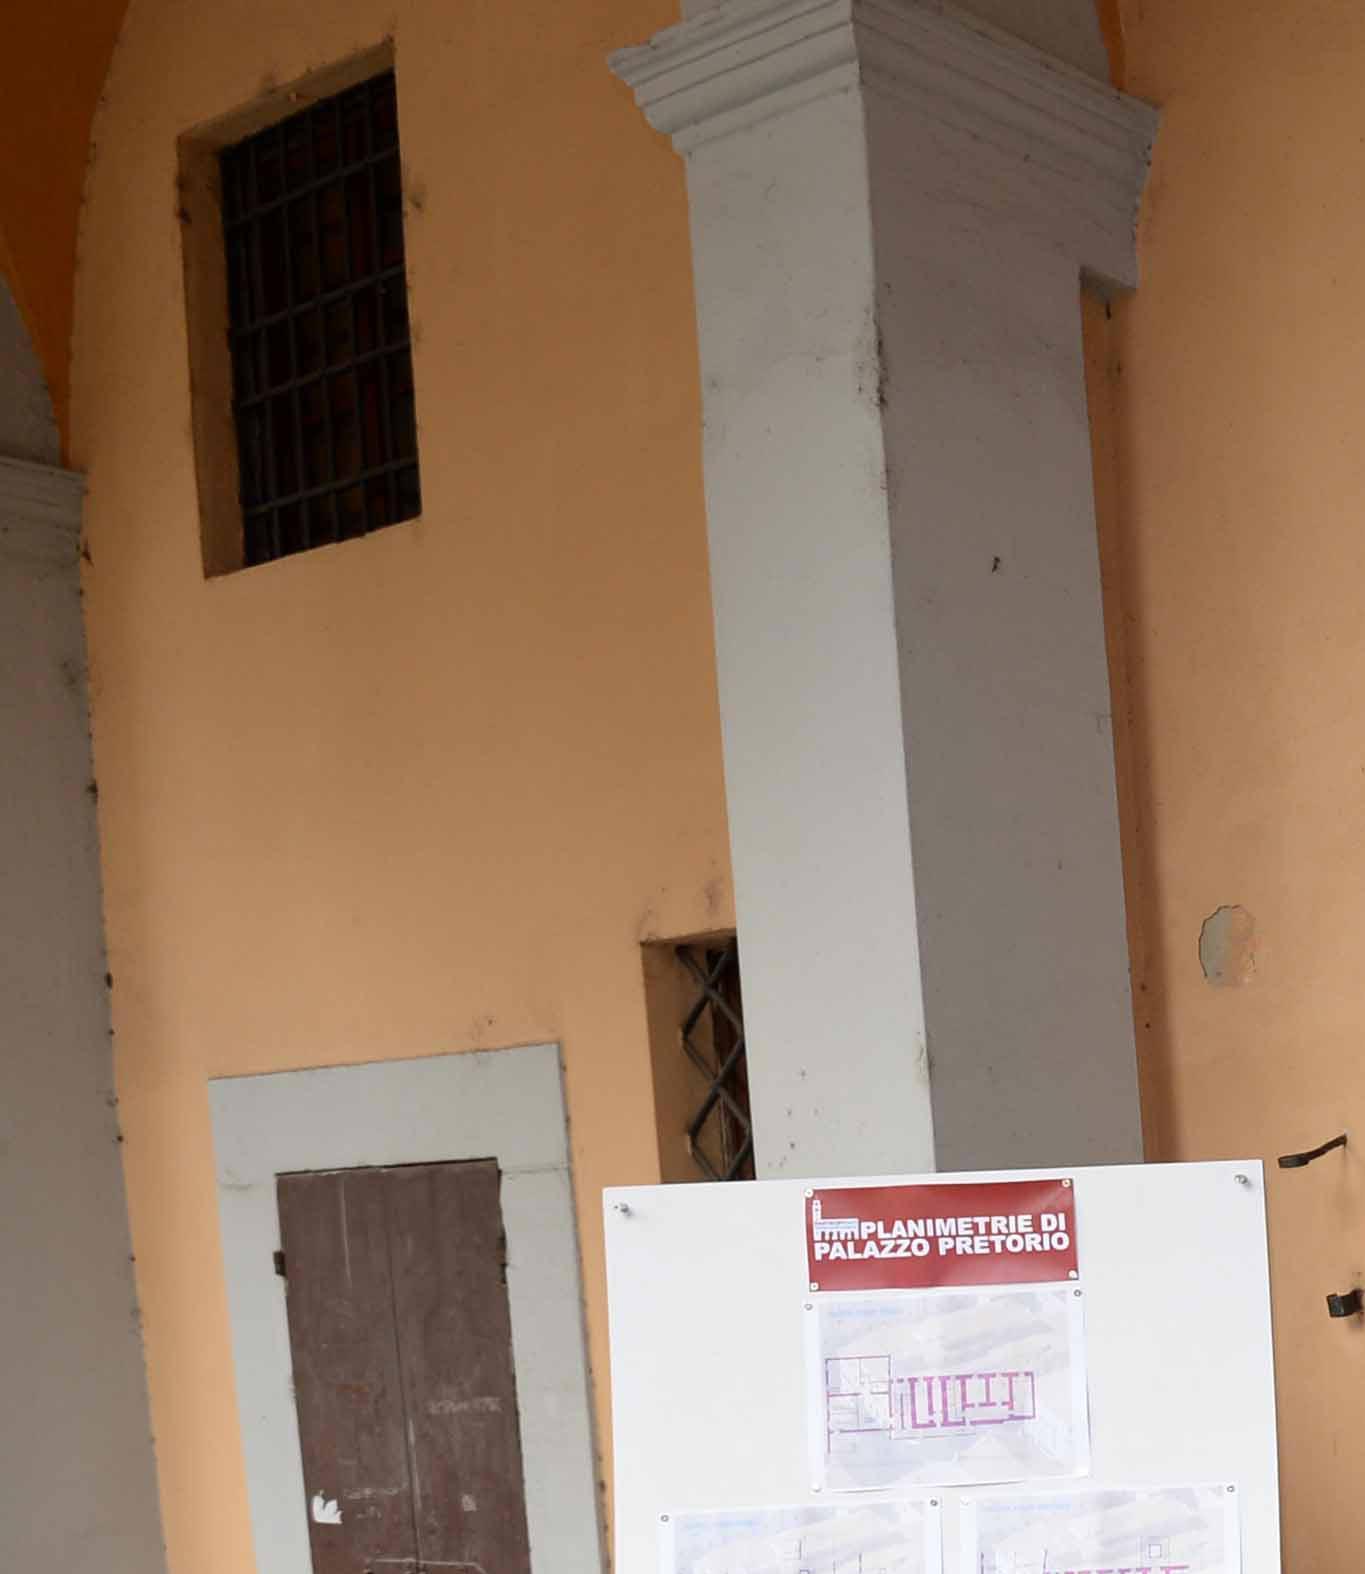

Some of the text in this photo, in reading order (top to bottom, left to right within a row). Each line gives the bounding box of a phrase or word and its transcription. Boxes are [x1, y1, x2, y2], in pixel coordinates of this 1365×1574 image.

[861, 1212, 1066, 1239] PLANIMETRIE DI
[813, 1231, 1070, 1261] PALAZZO PRETORIO
